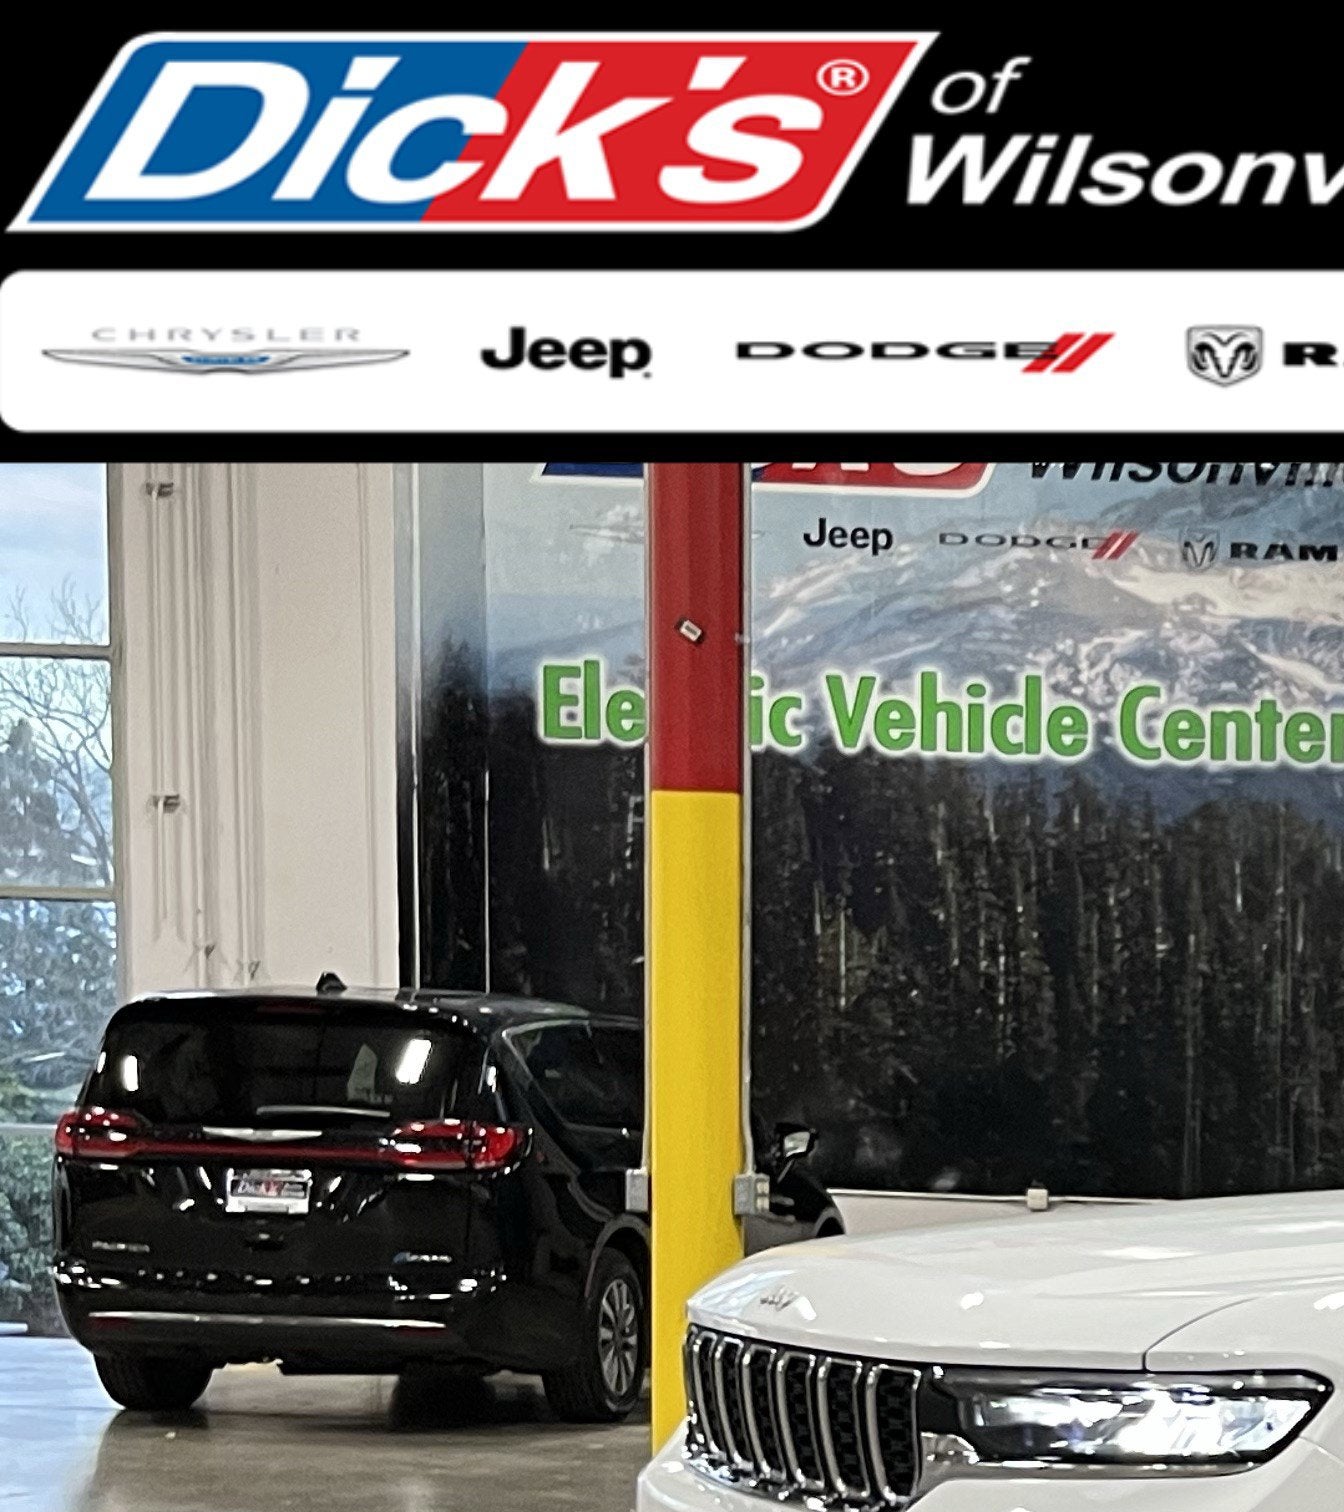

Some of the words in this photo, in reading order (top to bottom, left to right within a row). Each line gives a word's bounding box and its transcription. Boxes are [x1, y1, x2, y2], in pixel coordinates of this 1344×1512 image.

[803, 517, 893, 555] Jeep
[1229, 542, 1340, 562] RAM
[541, 660, 803, 745] Eleic
[825, 672, 1088, 755] Vehicle
